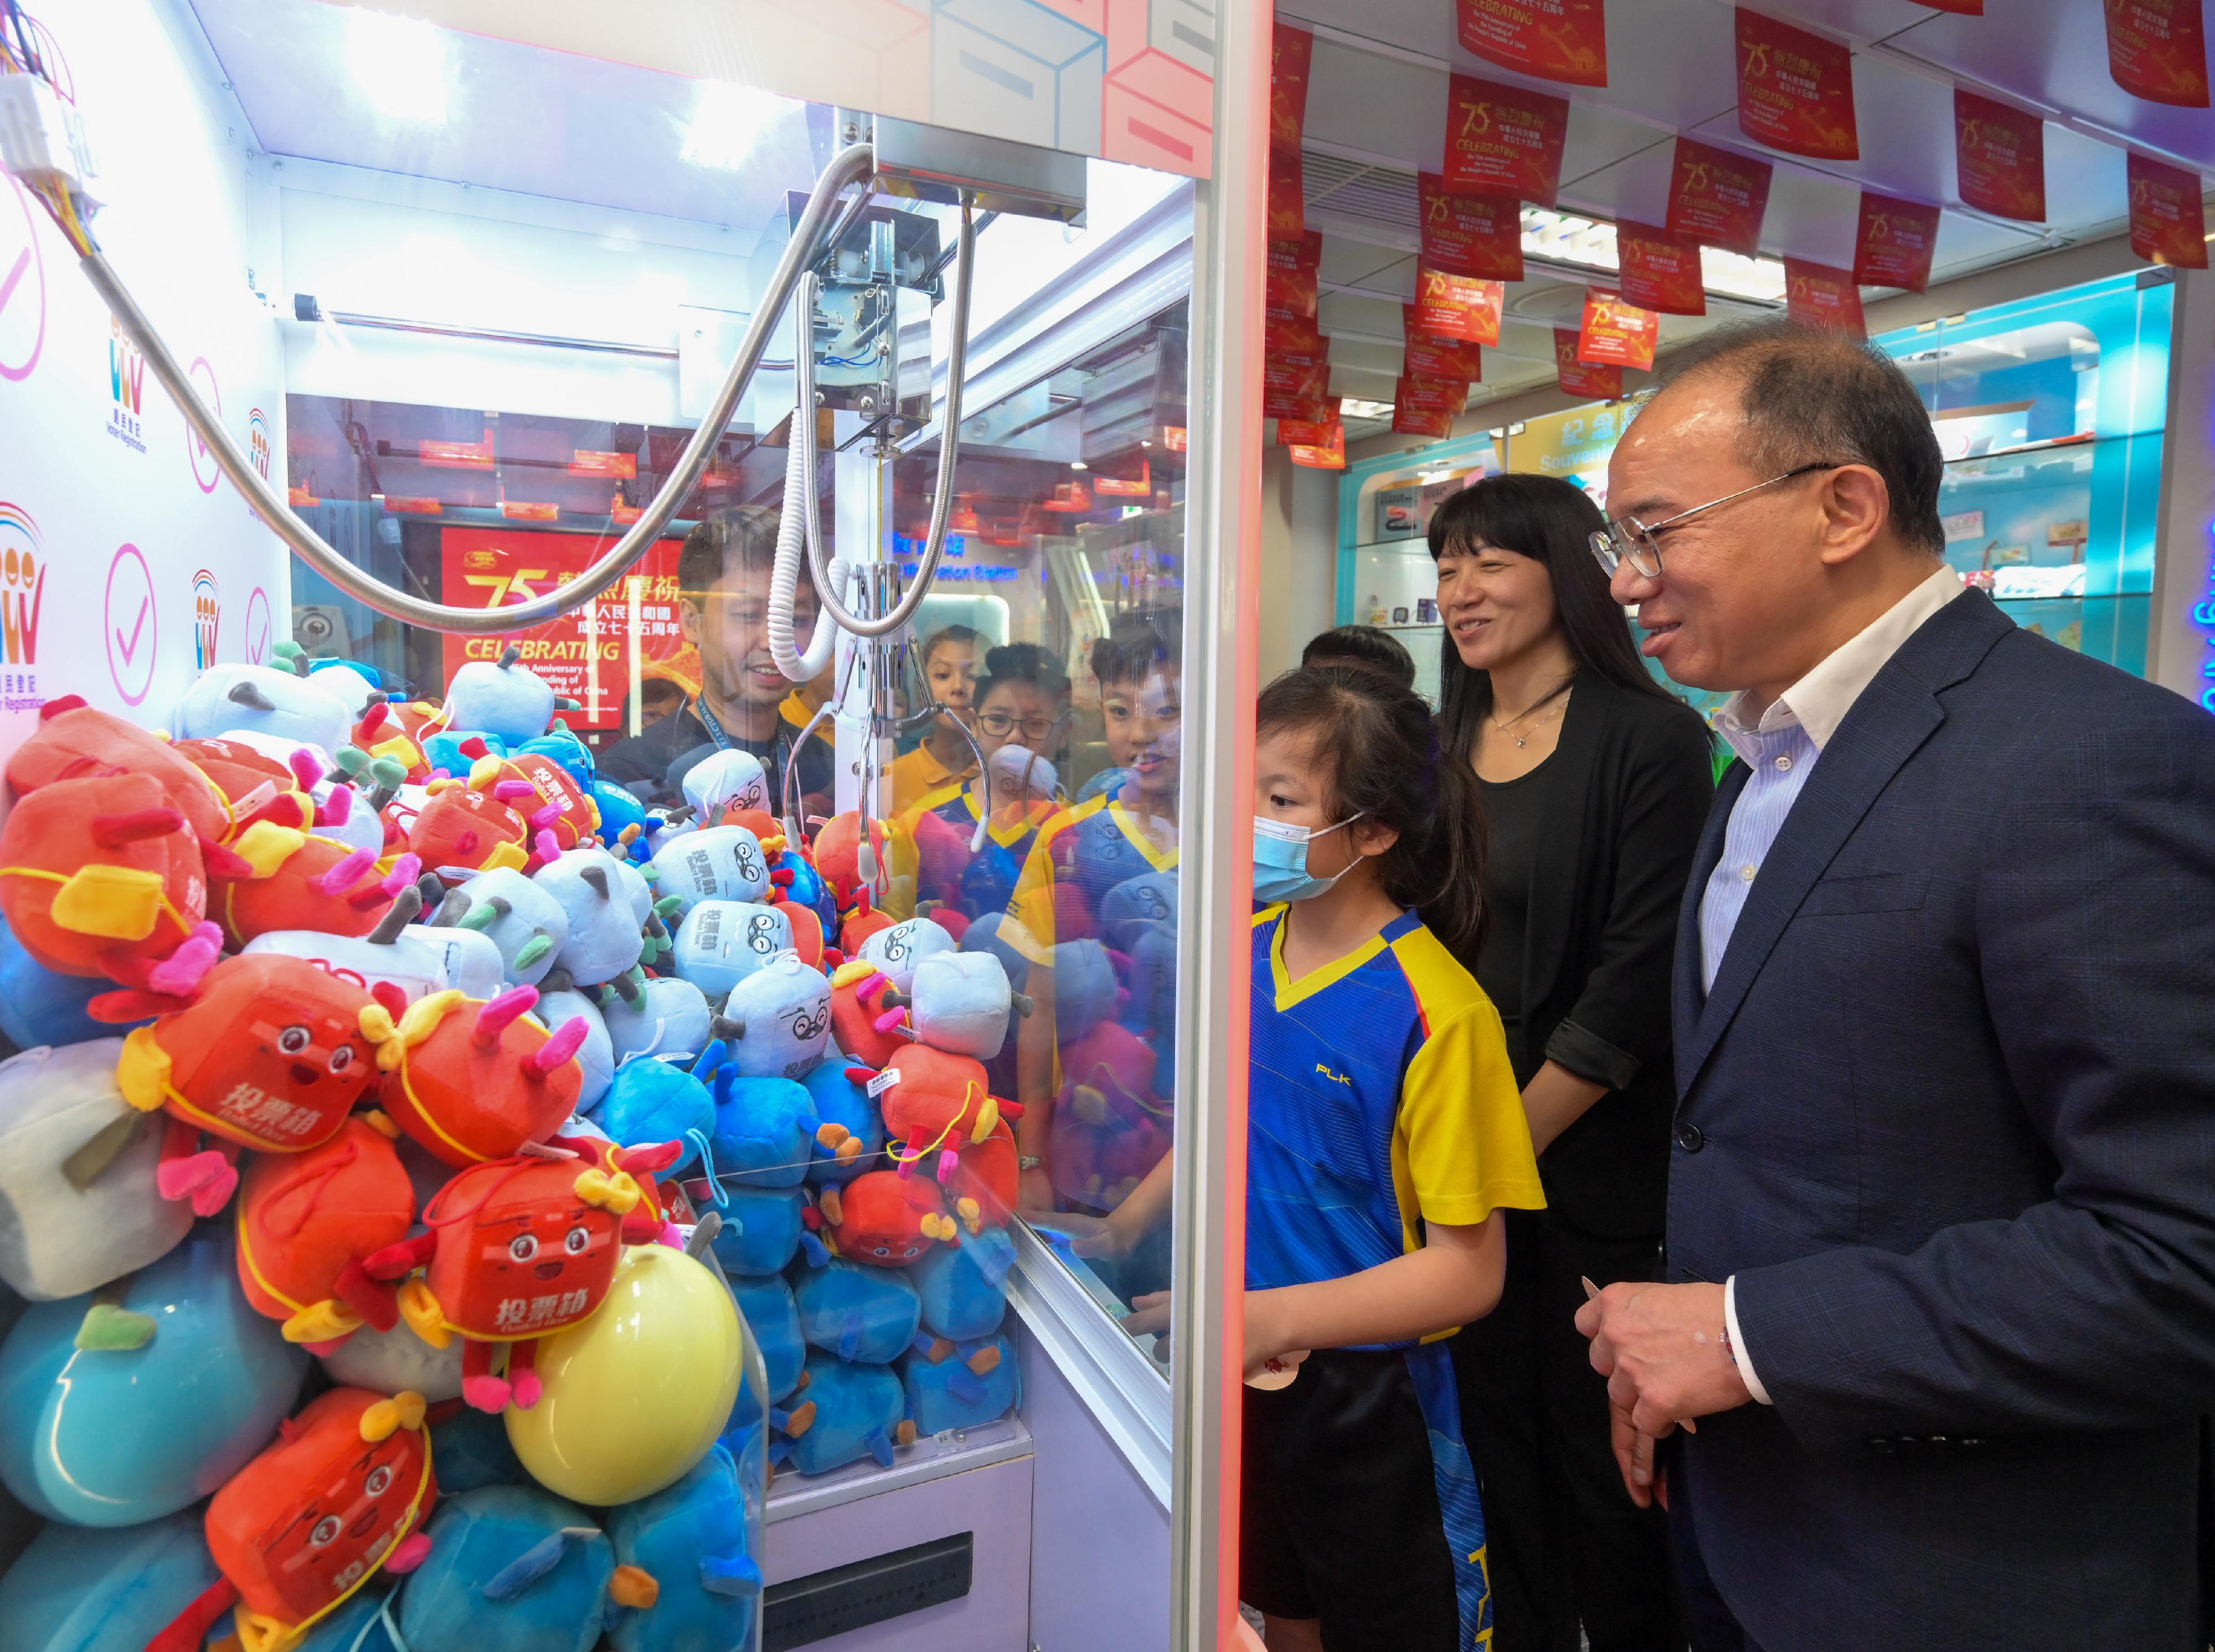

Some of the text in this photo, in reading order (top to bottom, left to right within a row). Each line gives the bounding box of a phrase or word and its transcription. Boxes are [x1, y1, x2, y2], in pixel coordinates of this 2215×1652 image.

[1465, 0, 1533, 25] ELEBRATING
[1480, 11, 1490, 20] 75th
[1490, 15, 1515, 31] Anniversary
[1491, 33, 1509, 44] Republic
[1514, 40, 1527, 50] China
[1742, 40, 1771, 77] 75
[1459, 102, 1492, 136] 75
[1456, 139, 1519, 159] CELEBRATING
[1683, 162, 1709, 193] 75
[1425, 195, 1450, 223] 75
[1867, 213, 1888, 240] 75
[1424, 272, 1446, 296] 75
[1422, 298, 1467, 312] CELEBRATING
[1591, 302, 1611, 326] 75
[106, 420, 146, 454] Voter Registration
[1562, 409, 1632, 446] 紀念
[463, 569, 549, 609] 75
[568, 604, 671, 620] 中華人民和國
[532, 665, 583, 675] Anniversary
[545, 675, 579, 685] nding of
[0, 675, 35, 693] 民登記
[552, 687, 608, 696] ublic of China
[700, 707, 727, 745] ELECTORAL
[532, 776, 550, 797] Ballot
[533, 767, 574, 811] 投票箱
[687, 856, 697, 876] Ballot
[692, 848, 717, 896] 投票箱
[697, 913, 706, 930] Ballot
[702, 909, 722, 950] 投票箱
[1316, 1063, 1352, 1086] PLK
[219, 1083, 322, 1135] 投票箱
[494, 1288, 589, 1325] 投票箱
